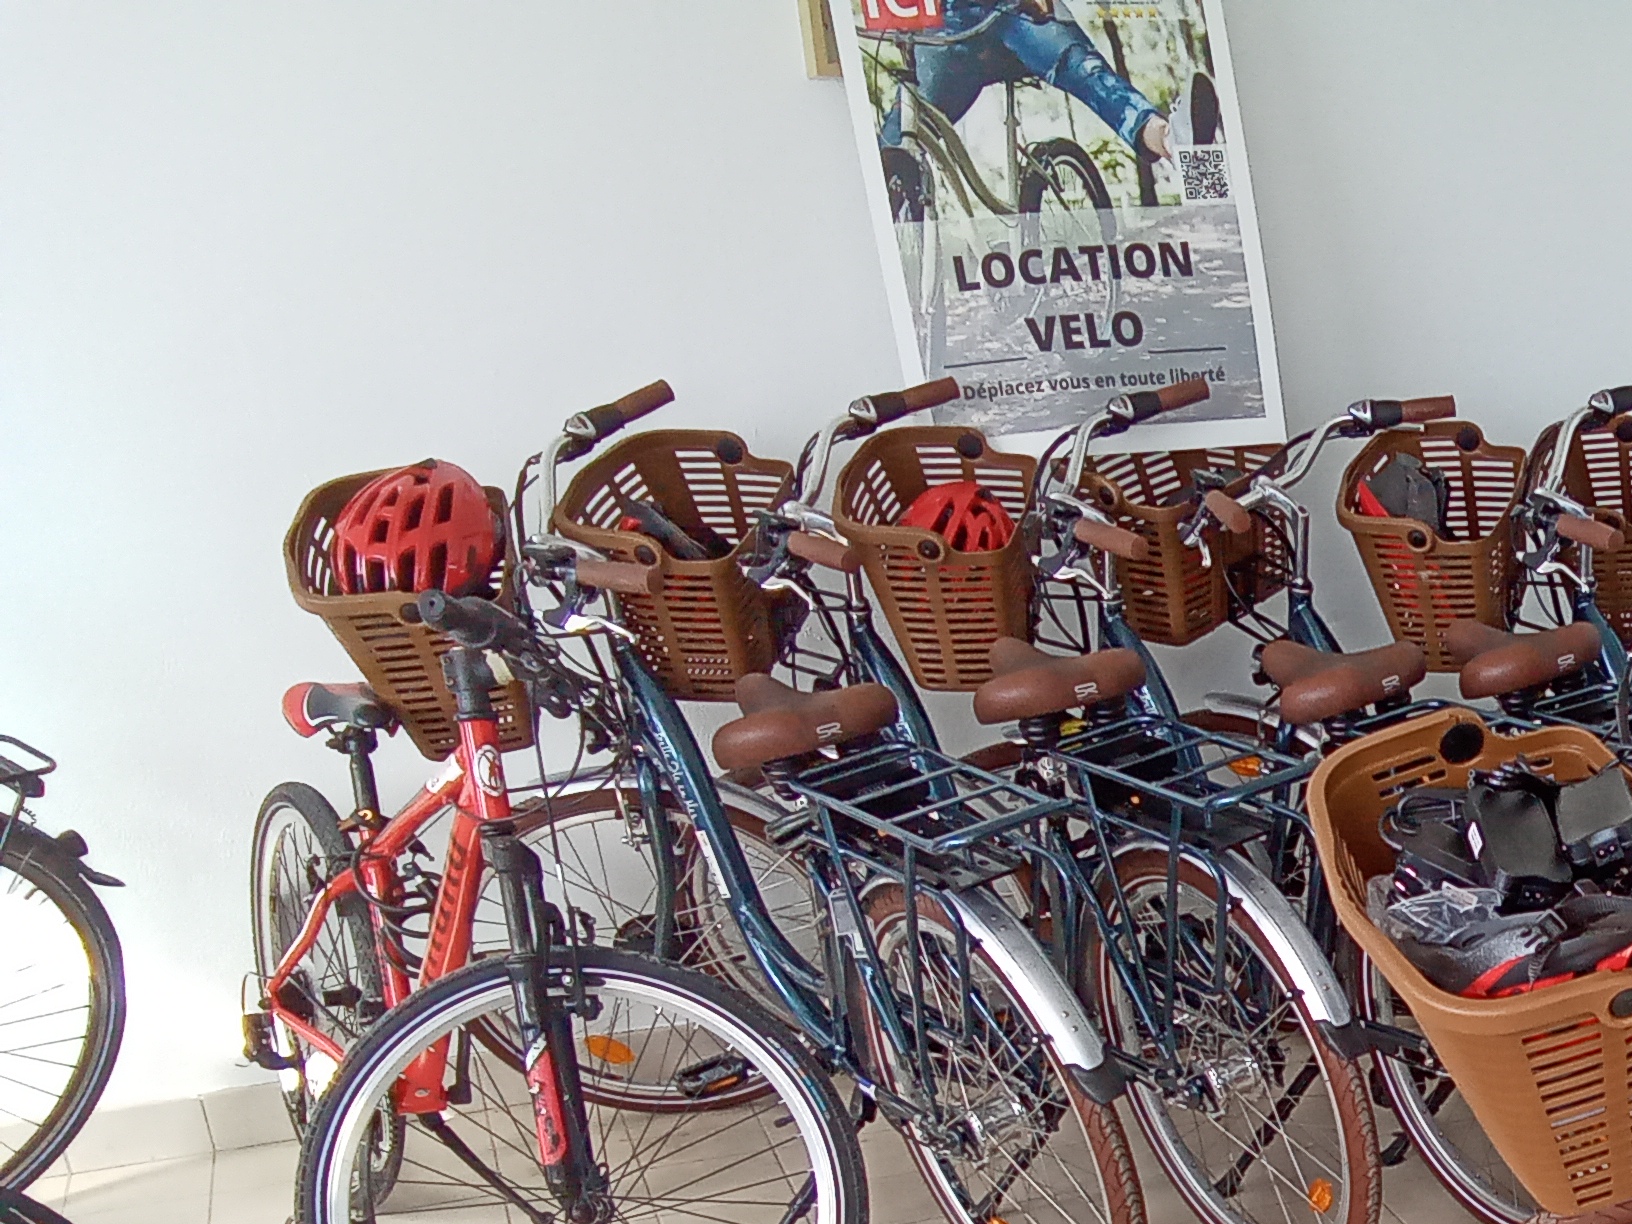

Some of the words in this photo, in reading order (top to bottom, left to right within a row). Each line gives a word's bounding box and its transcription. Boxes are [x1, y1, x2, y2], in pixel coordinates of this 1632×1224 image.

[952, 241, 1194, 292] LOCATION
[1023, 310, 1144, 352] VELO
[962, 379, 1045, 403] Déplacez
[1050, 375, 1091, 392] vous
[1095, 375, 1116, 389] en
[1120, 369, 1166, 387] toute
[1169, 365, 1226, 384] liberté
